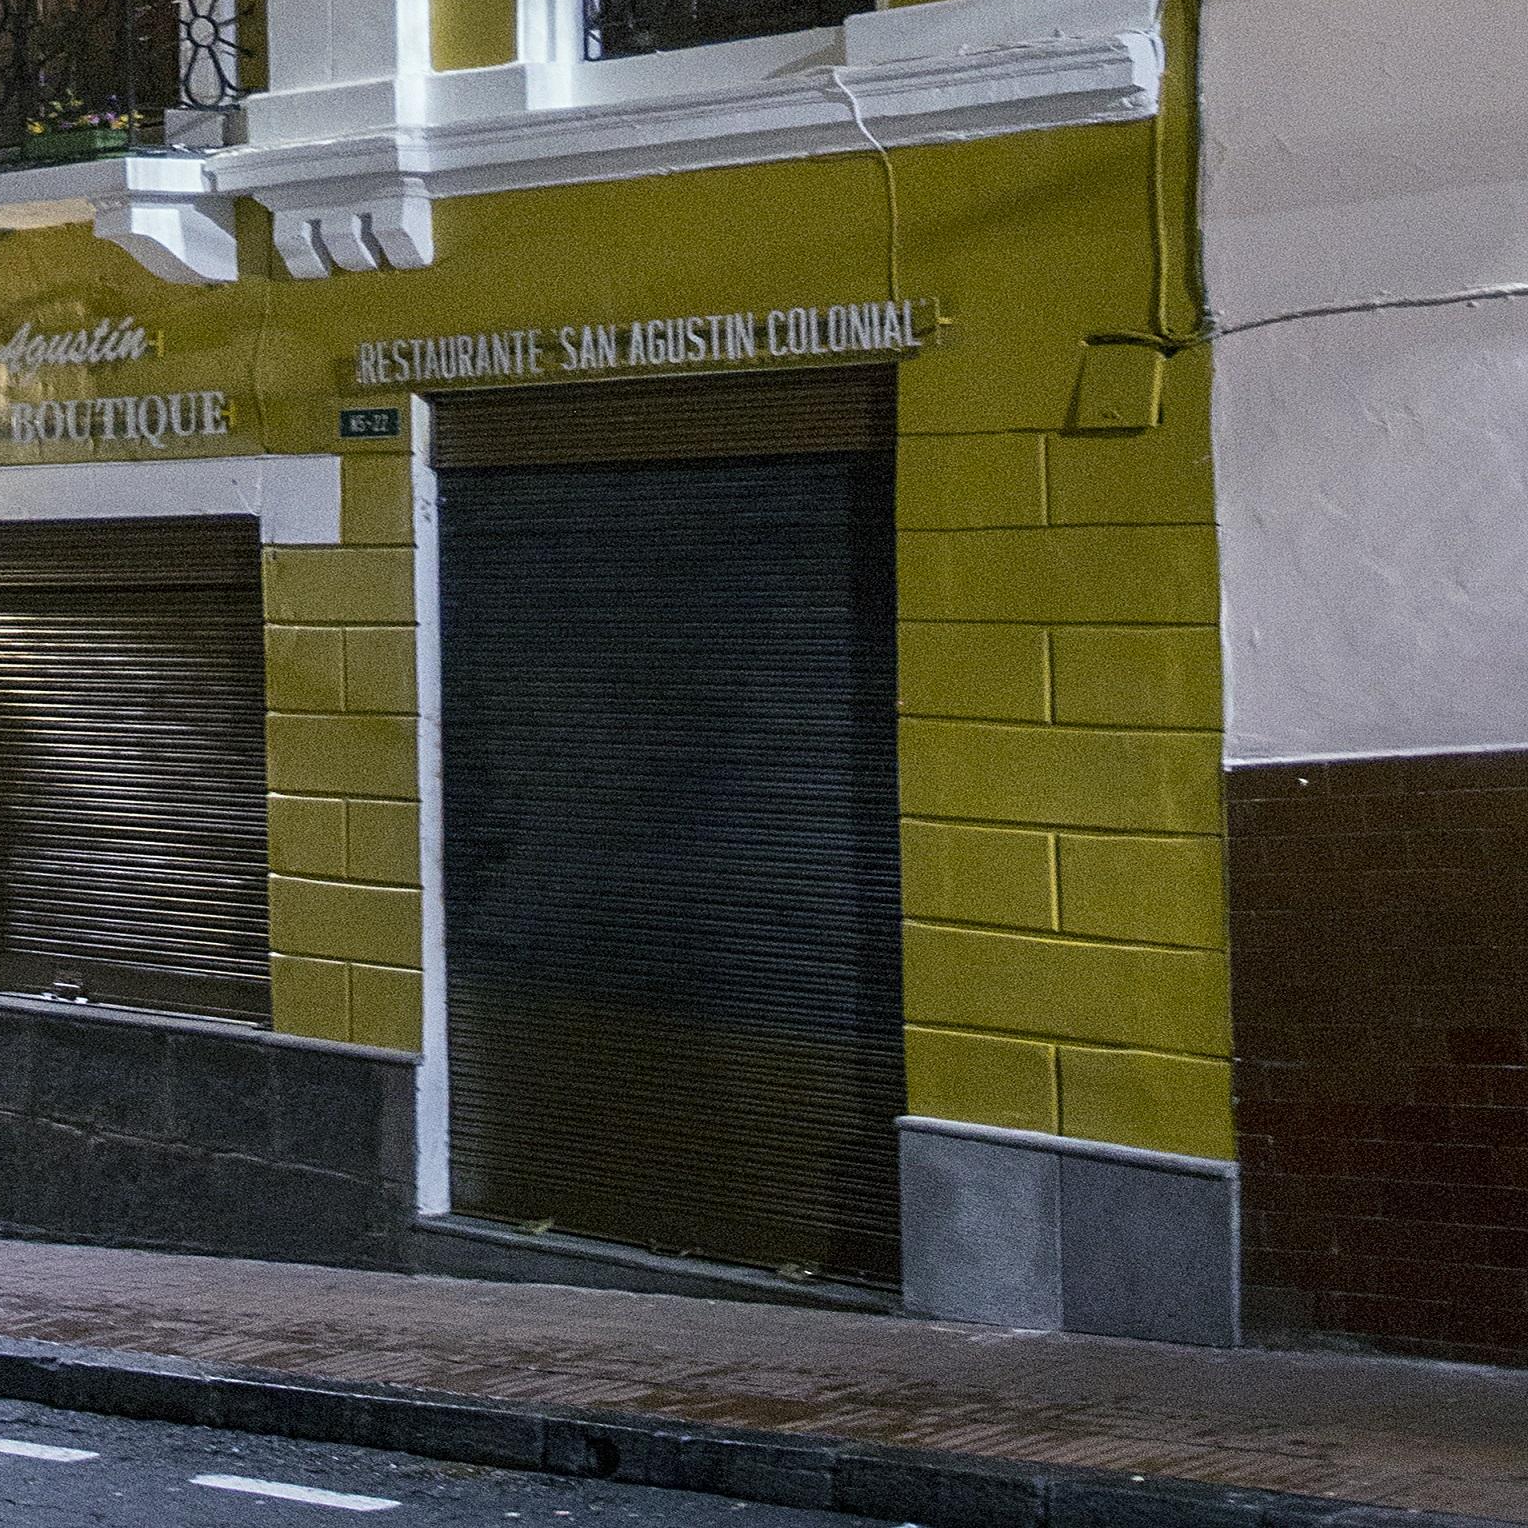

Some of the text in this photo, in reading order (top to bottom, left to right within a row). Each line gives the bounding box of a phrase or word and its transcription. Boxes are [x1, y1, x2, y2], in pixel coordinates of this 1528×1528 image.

[356, 328, 542, 385] RESTAURANTE
[629, 311, 756, 367] AGUSTIN
[9, 390, 228, 448] BOUTIQUE
